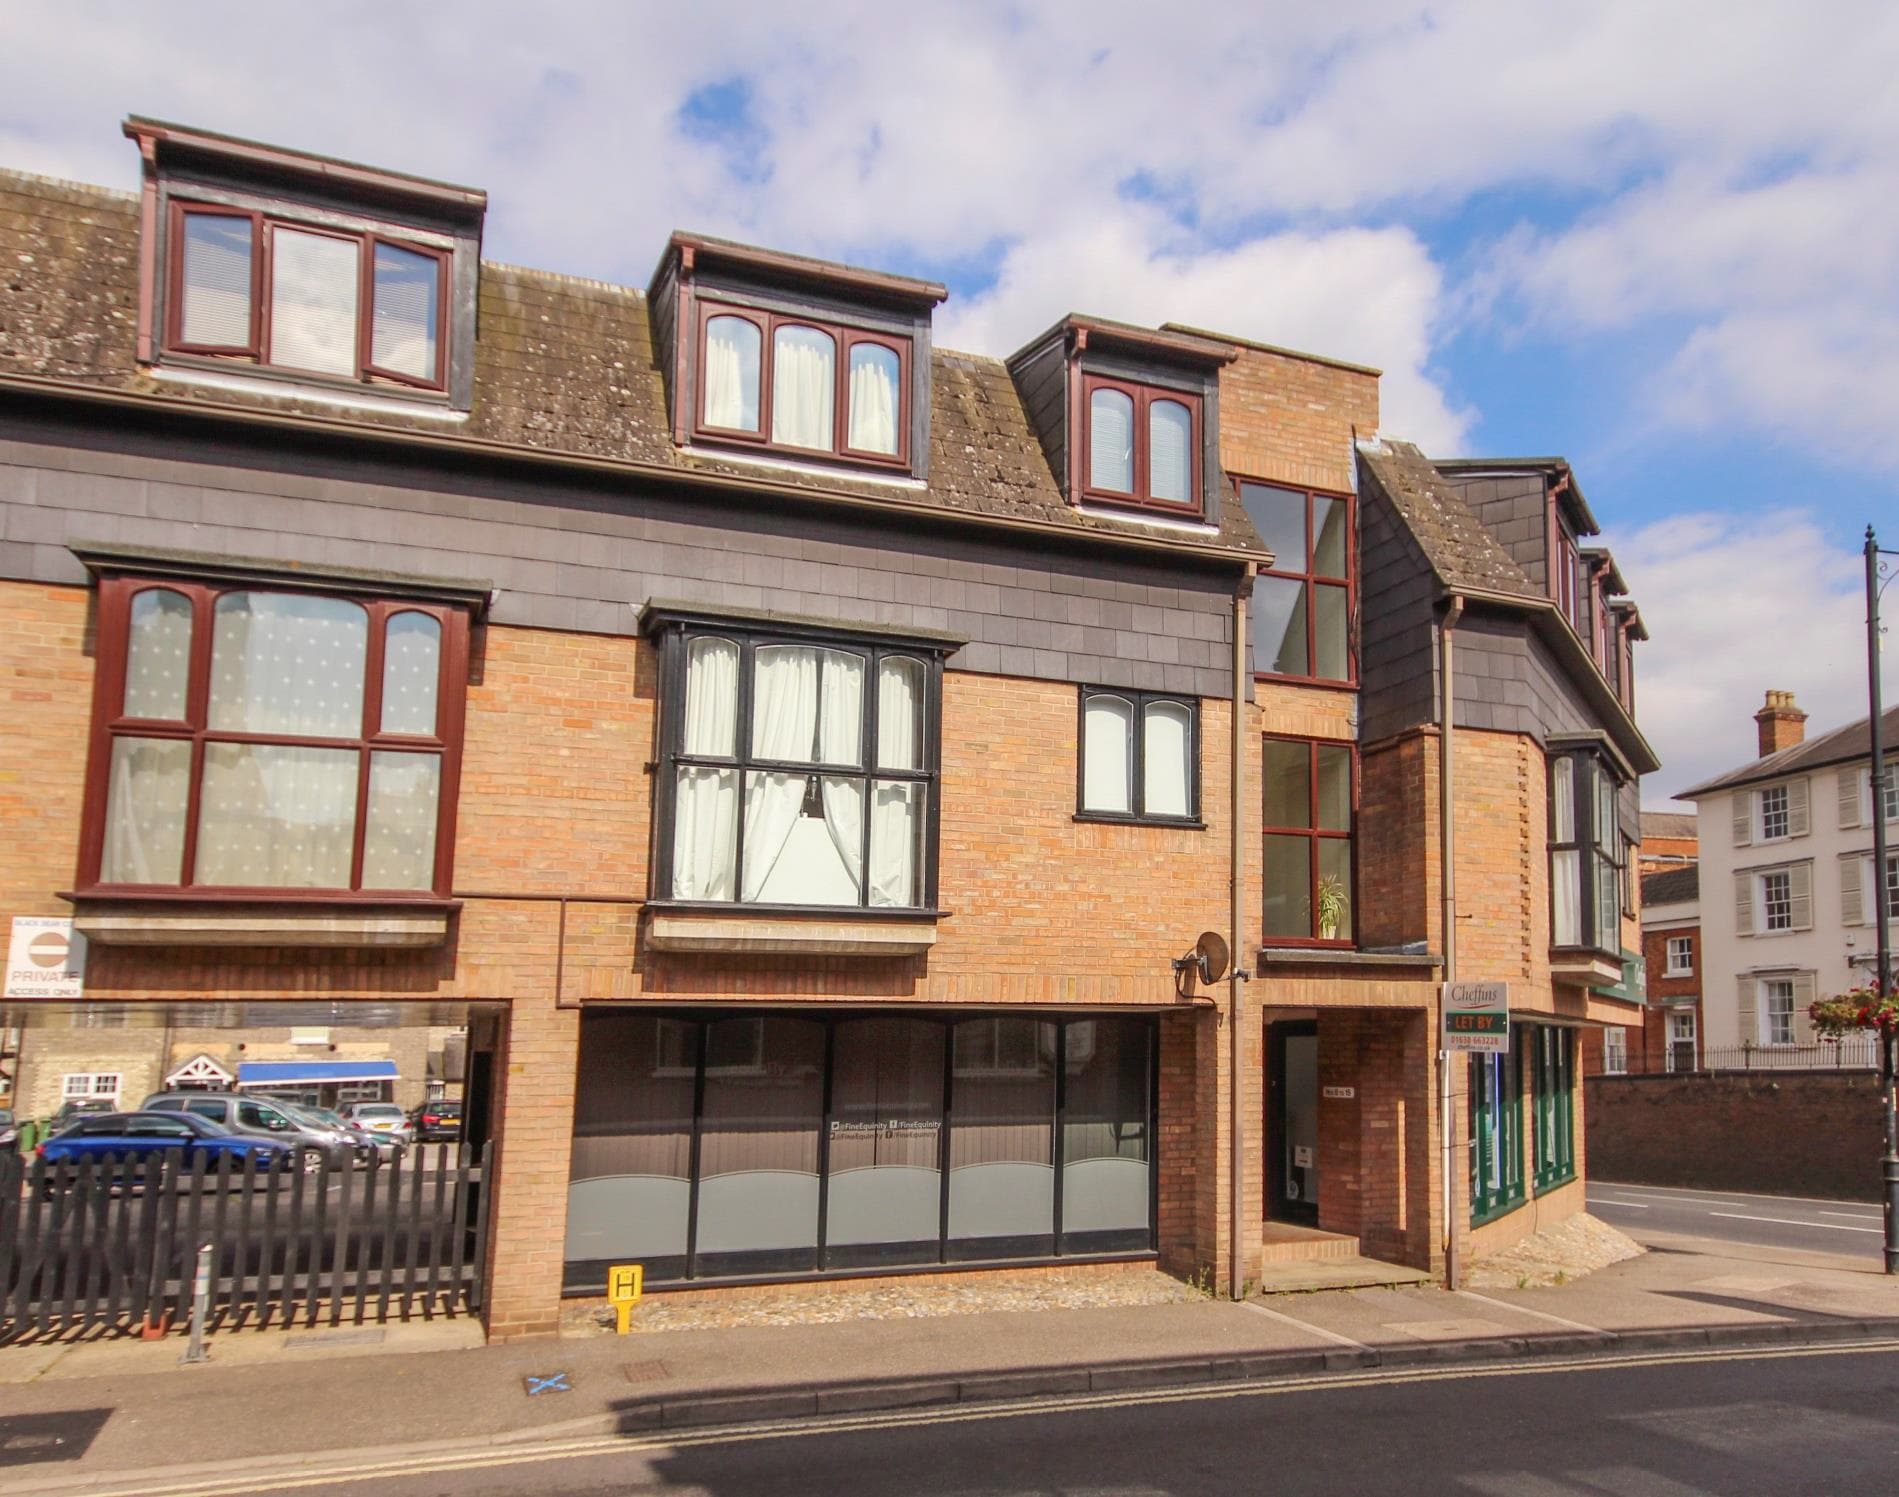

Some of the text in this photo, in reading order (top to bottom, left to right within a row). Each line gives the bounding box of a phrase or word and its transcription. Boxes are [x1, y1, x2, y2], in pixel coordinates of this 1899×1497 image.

[12, 971, 80, 982] PRIVATE
[53, 988, 77, 996] ONLY
[1451, 984, 1497, 1004] Cheffins
[1455, 1015, 1494, 1029] LET BY
[616, 1272, 635, 1298] H
